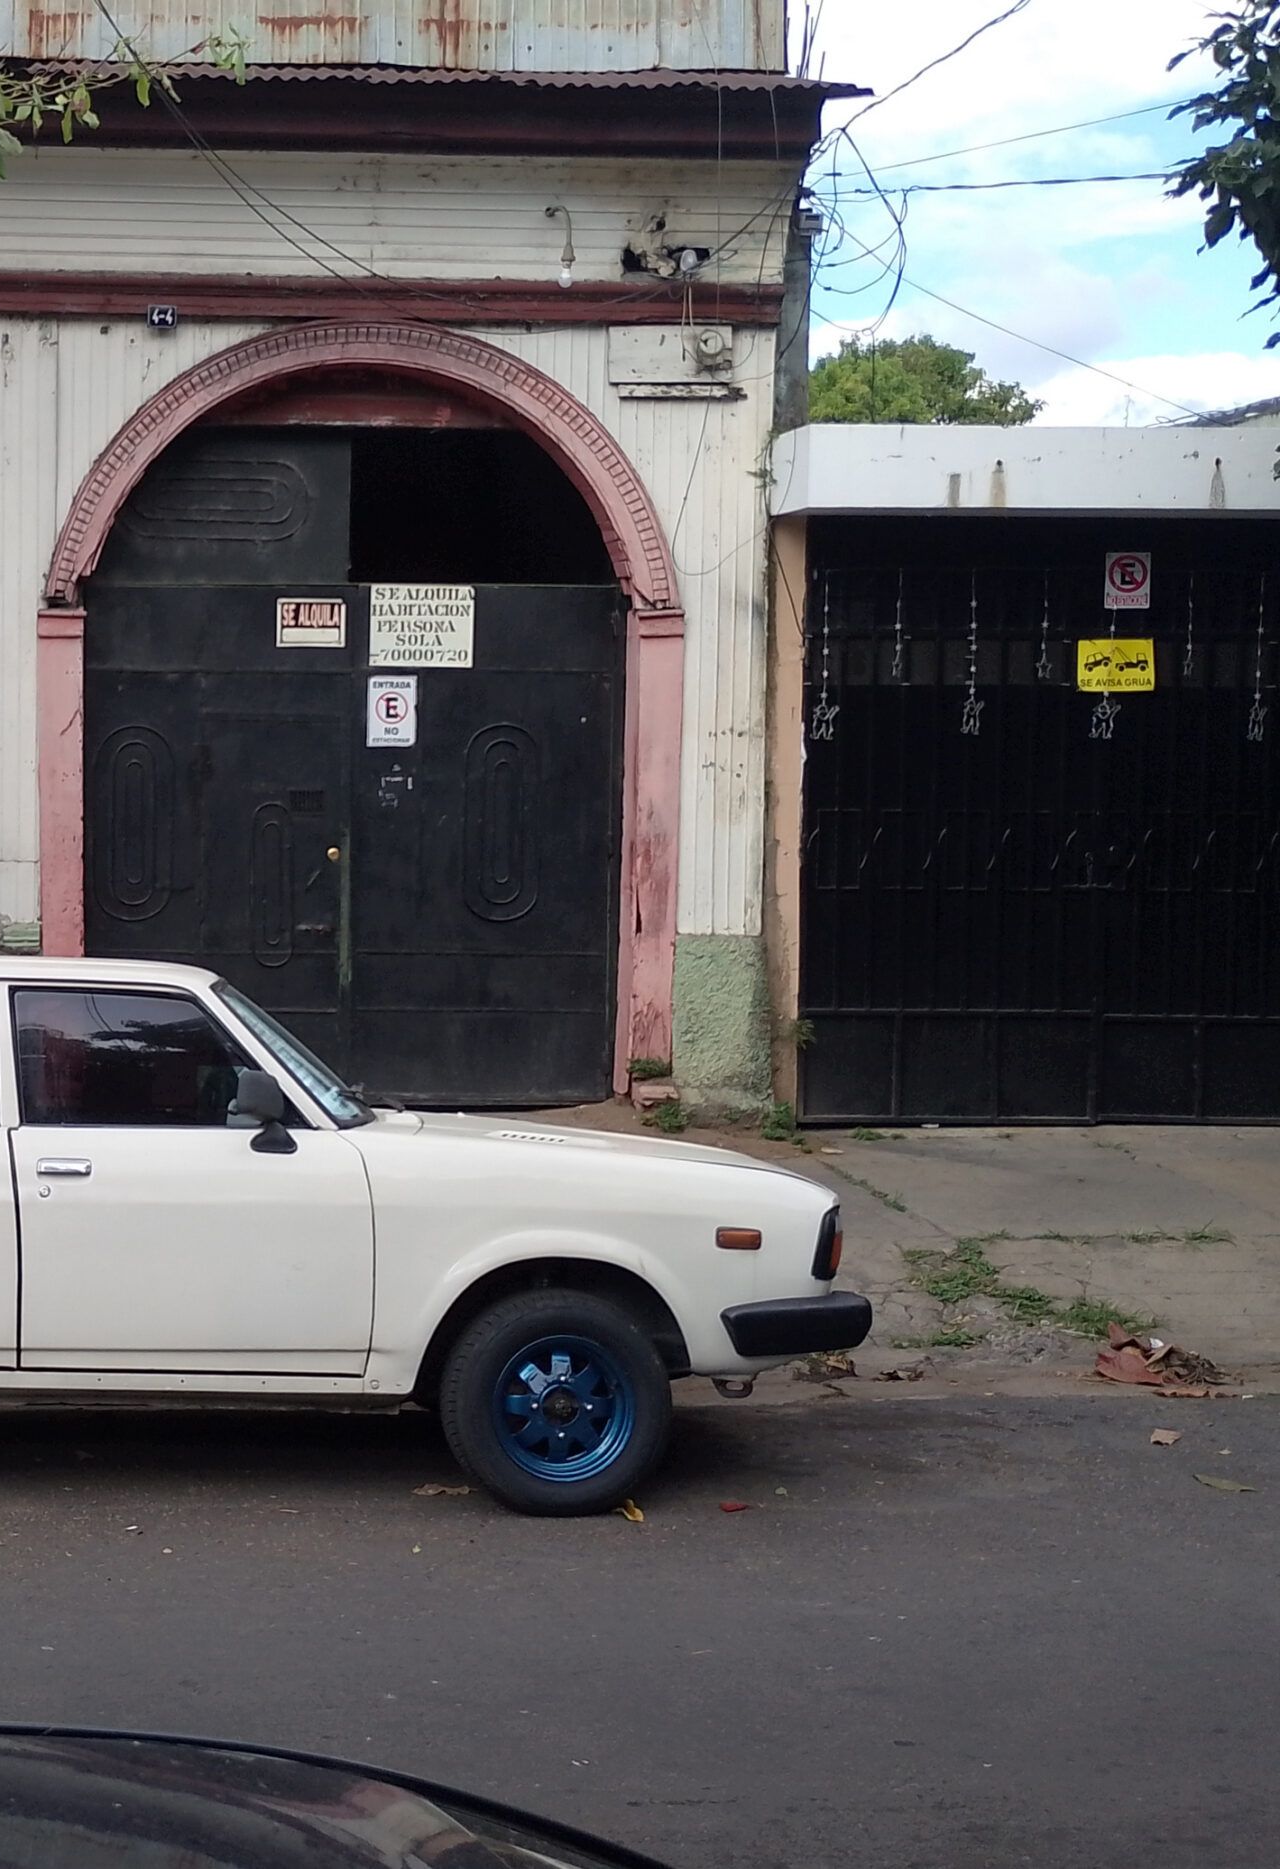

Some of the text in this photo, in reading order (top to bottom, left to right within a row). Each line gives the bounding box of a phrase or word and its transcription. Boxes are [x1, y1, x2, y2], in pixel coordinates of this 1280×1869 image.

[375, 587, 473, 601] SE ALQUILA
[282, 604, 340, 629] SE ALQUILA
[371, 603, 471, 617] HABITACION
[376, 620, 456, 633] PERSONA
[395, 634, 443, 646] SOLA
[372, 681, 412, 689] ENTRADA
[1080, 677, 1152, 687] SE AVISA GRUA
[385, 697, 399, 719] E
[384, 727, 399, 736] NO
